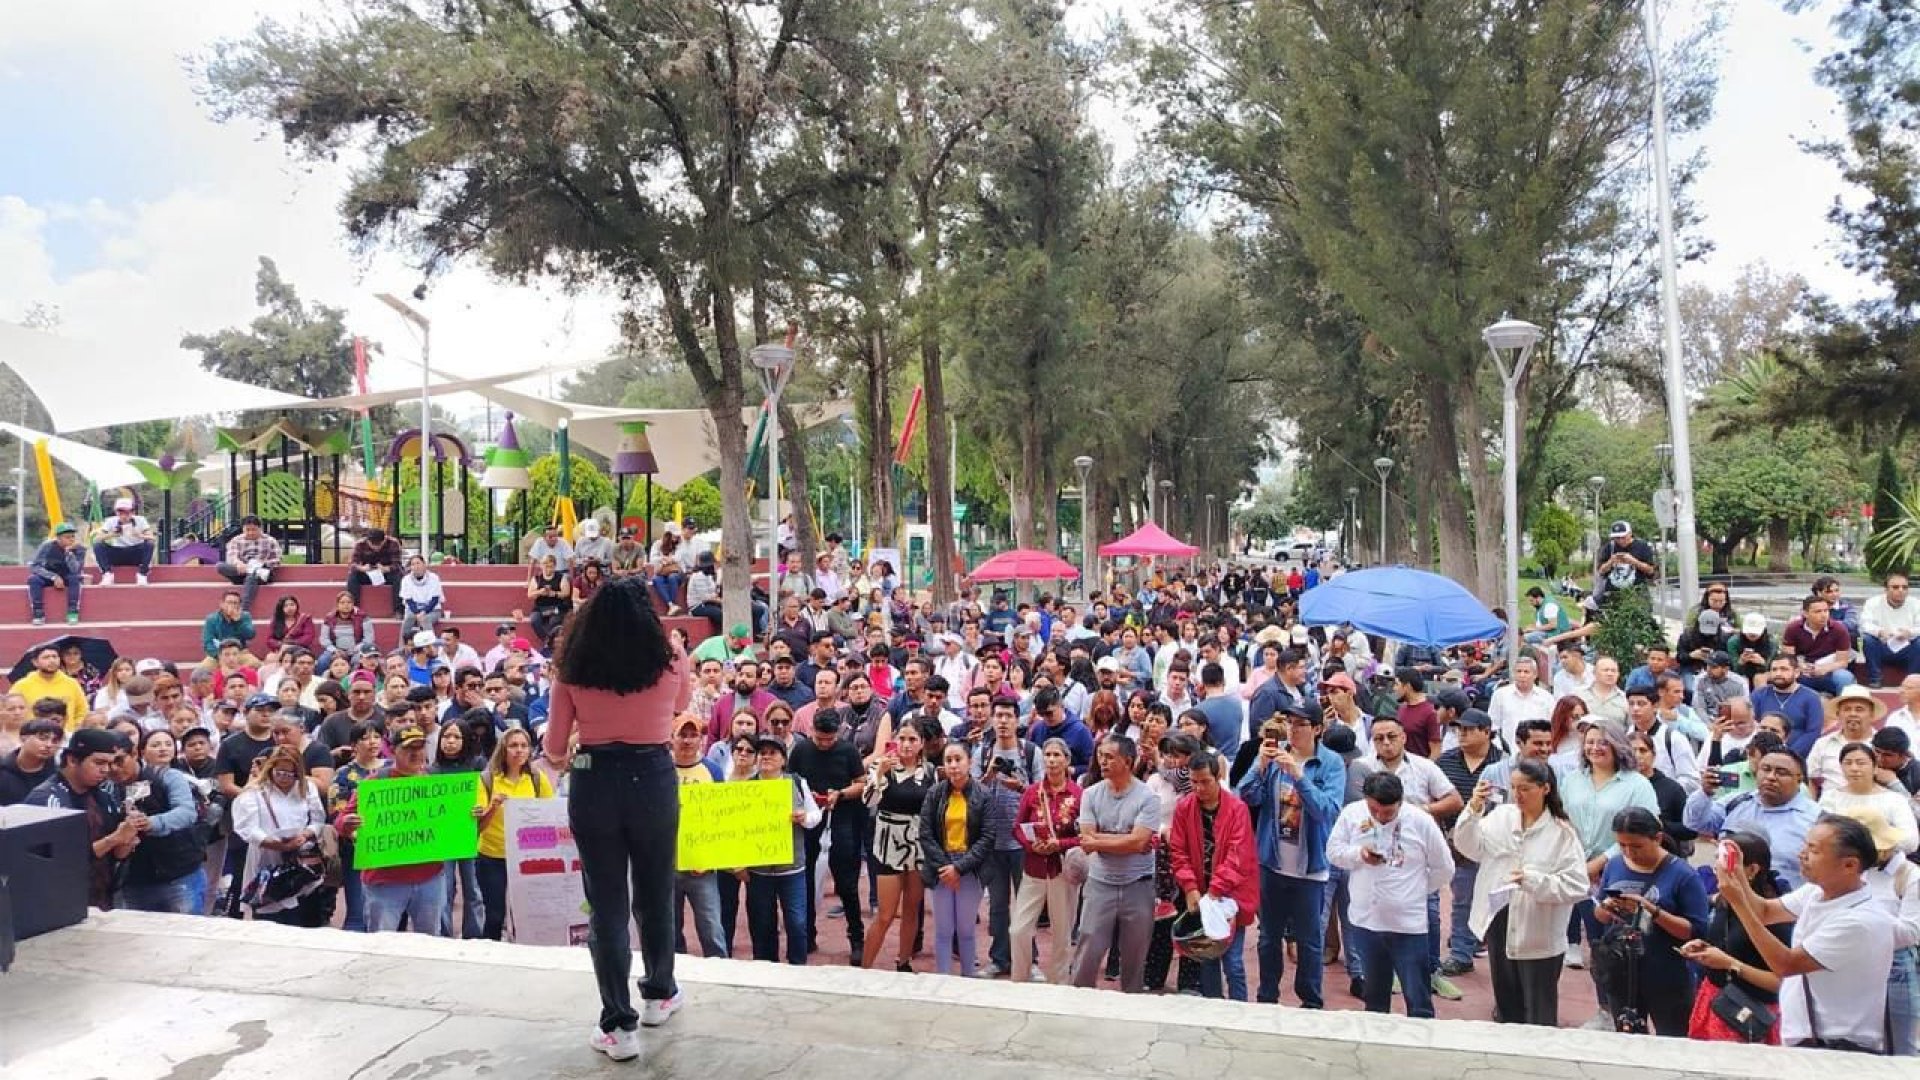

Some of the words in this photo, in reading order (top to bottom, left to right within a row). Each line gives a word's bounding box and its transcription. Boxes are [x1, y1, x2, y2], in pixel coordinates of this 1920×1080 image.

[375, 809, 418, 829] APOYA
[428, 803, 447, 818] LA
[366, 828, 436, 853] REFORMA
